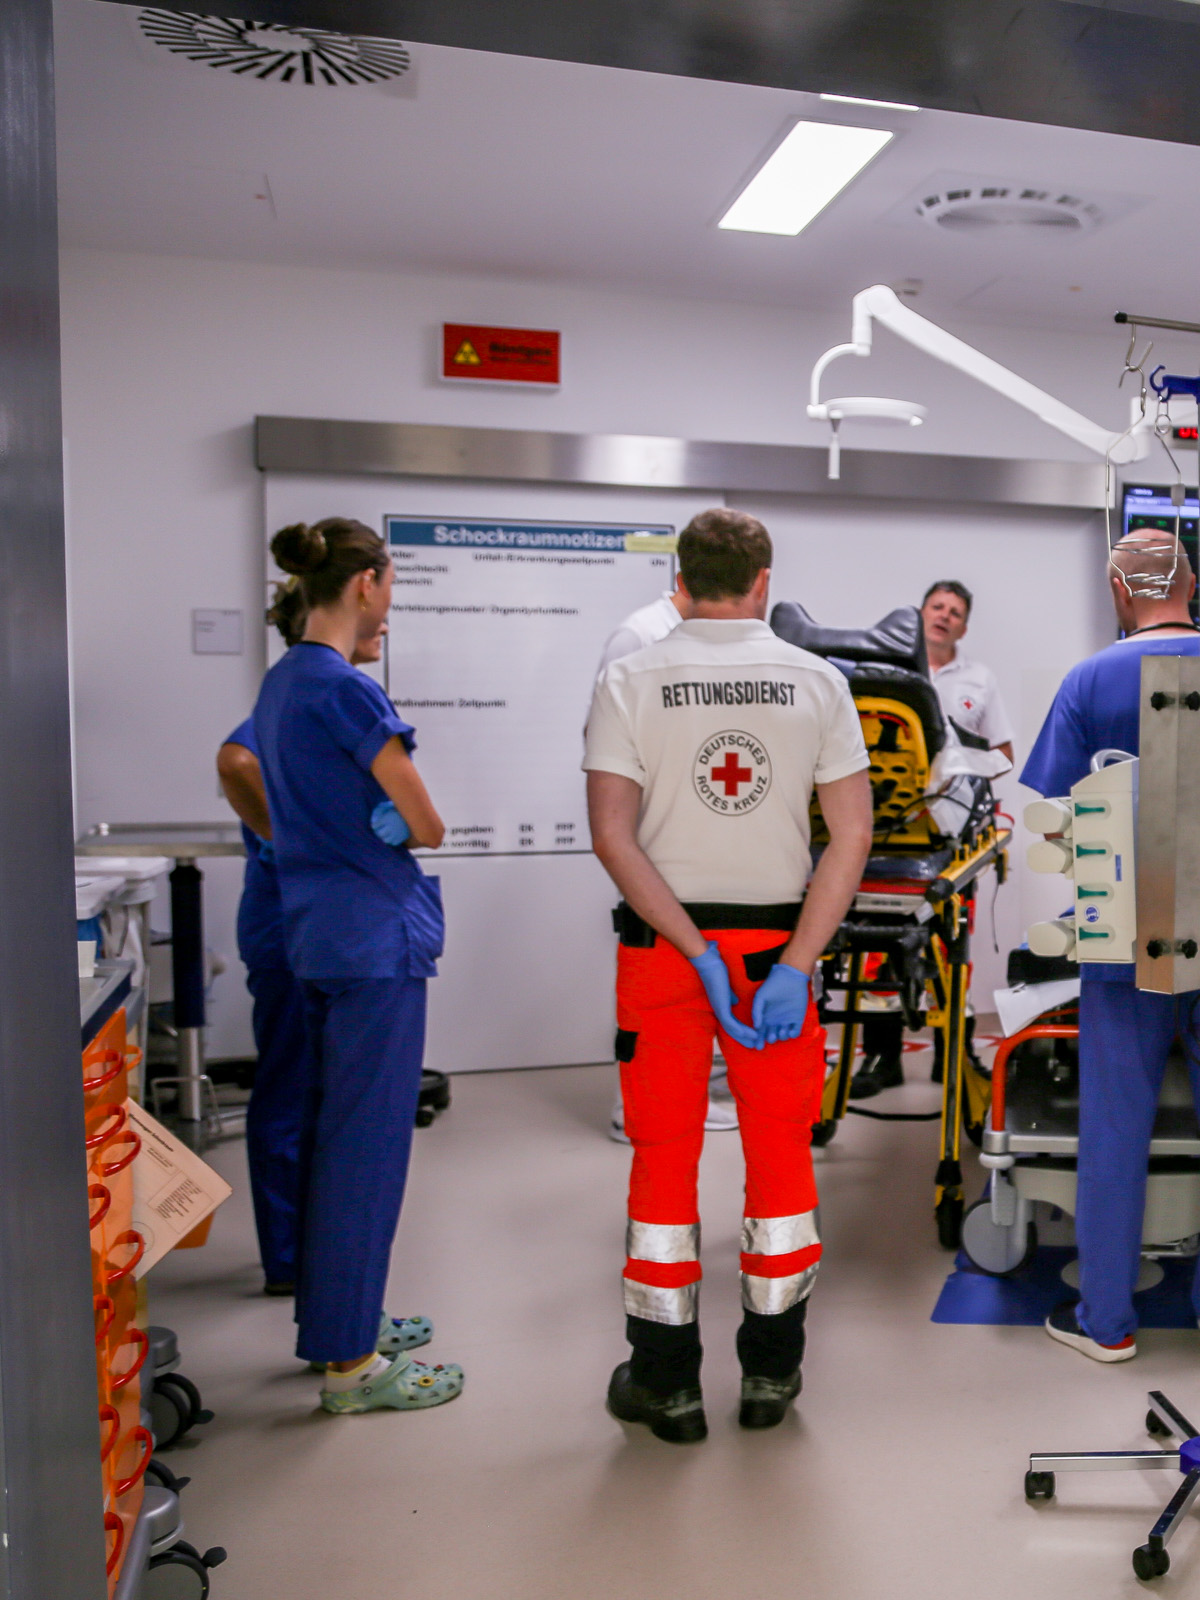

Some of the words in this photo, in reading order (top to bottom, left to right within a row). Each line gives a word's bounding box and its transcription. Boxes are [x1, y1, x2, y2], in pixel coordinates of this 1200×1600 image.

[432, 524, 626, 549] Schockraumnotizen
[661, 680, 796, 708] RETTUNGSDIENST
[698, 734, 766, 766] DEUTSCHES
[696, 775, 729, 811] ROTES
[733, 775, 768, 811] KREUZ
